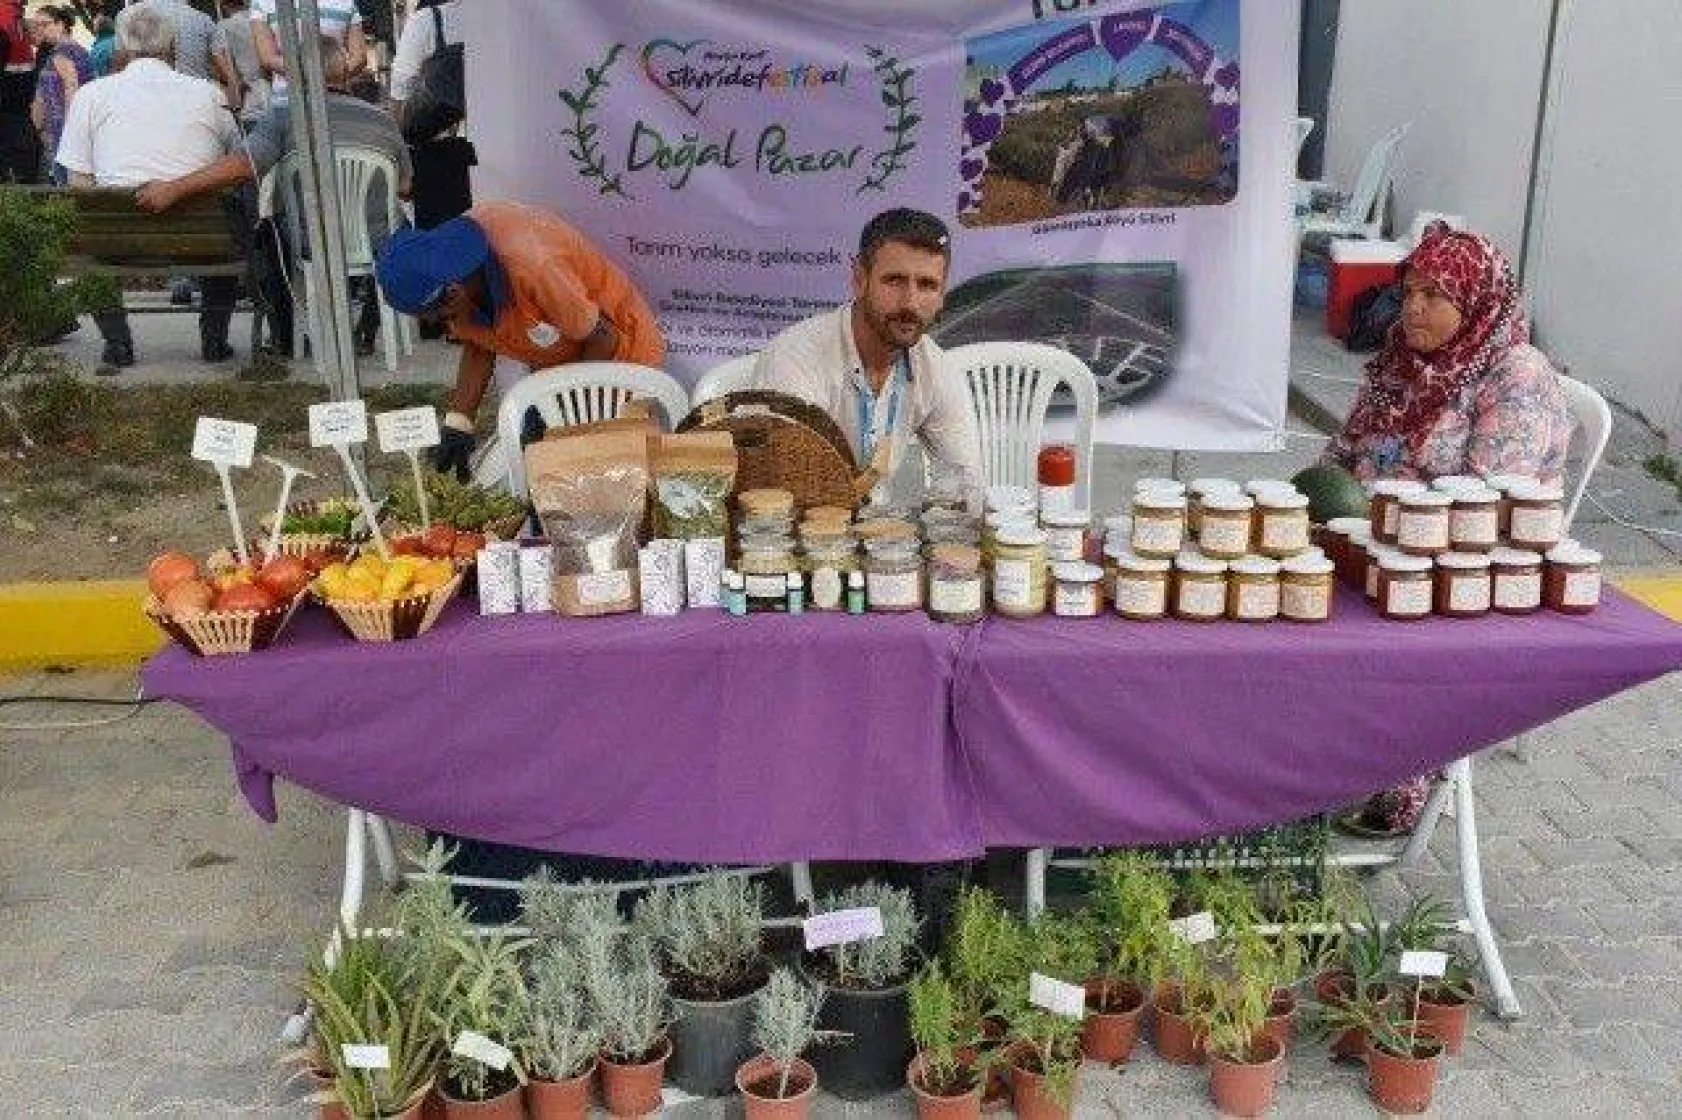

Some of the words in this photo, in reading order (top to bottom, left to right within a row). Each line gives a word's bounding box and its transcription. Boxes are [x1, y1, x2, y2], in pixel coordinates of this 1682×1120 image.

[628, 120, 739, 190] Doğal
[756, 123, 864, 174] Pazar
[625, 235, 681, 258] Tarım
[690, 244, 750, 262] yoksa
[758, 246, 841, 269] gelecek
